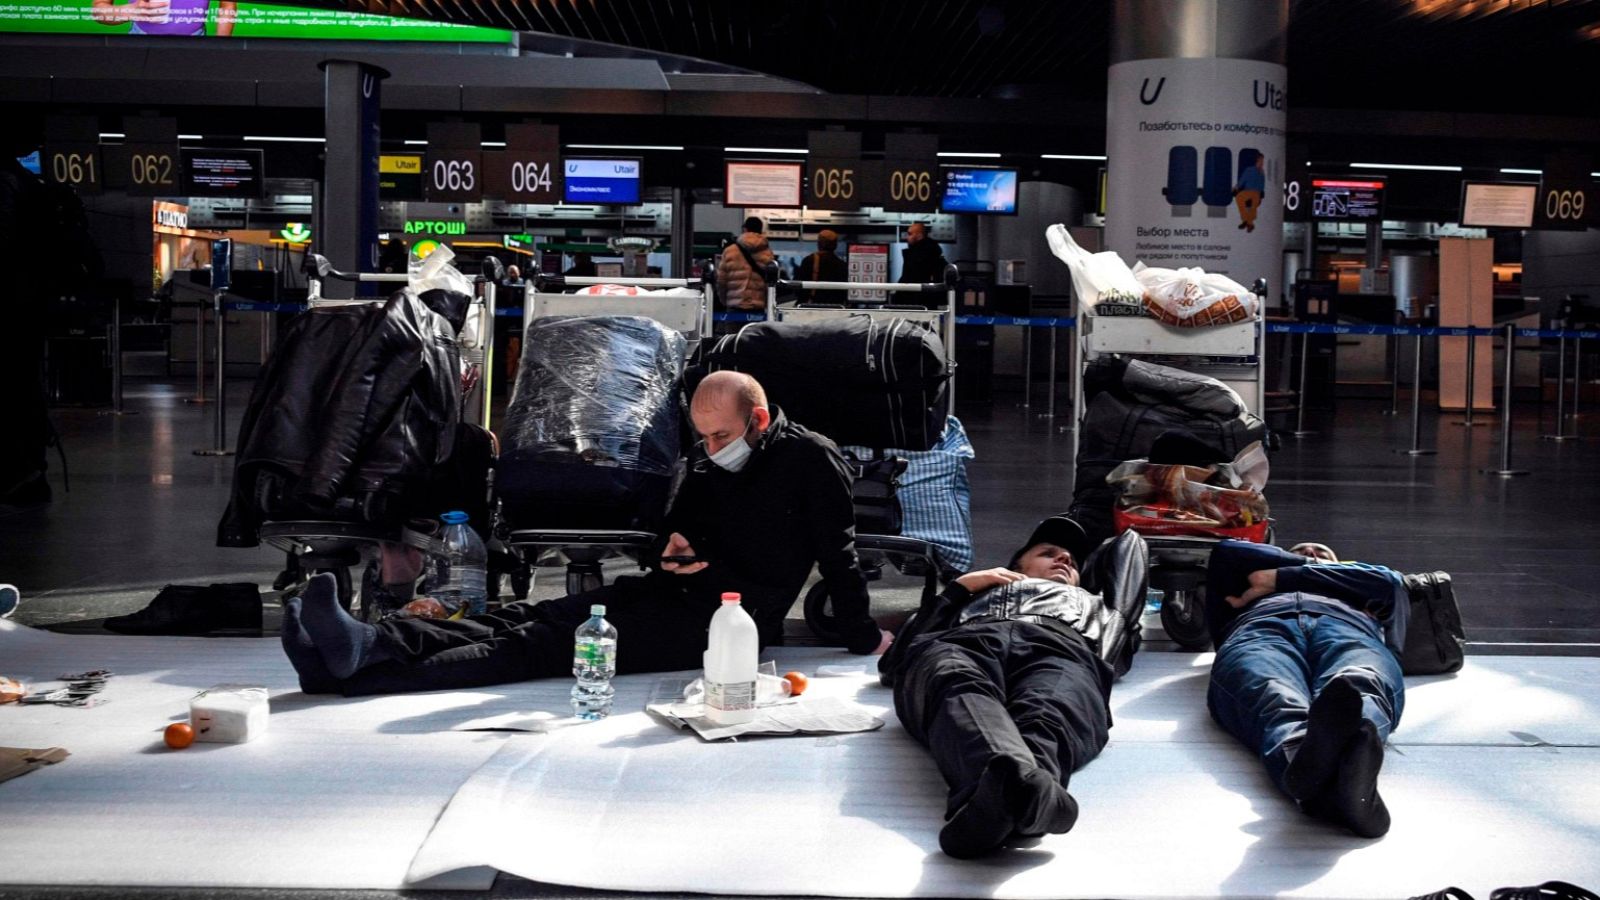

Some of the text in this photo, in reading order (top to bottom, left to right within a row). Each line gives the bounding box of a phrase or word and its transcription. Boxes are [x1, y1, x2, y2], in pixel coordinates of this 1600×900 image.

[1138, 121, 1213, 132] Позаботьтесь
[1214, 124, 1221, 132] о
[1222, 124, 1269, 135] комфорте
[53, 153, 97, 183] 061
[131, 154, 173, 184] 062
[396, 159, 417, 169] Utair
[433, 160, 475, 190] 063
[511, 161, 552, 192] 064
[613, 164, 637, 174] Utair
[813, 168, 854, 199] 065
[890, 171, 931, 201] 066
[1545, 190, 1585, 220] 069
[1135, 242, 1170, 251] Любимое
[1136, 226, 1209, 238] Выбор места
[1180, 254, 1229, 262] попутчиком
